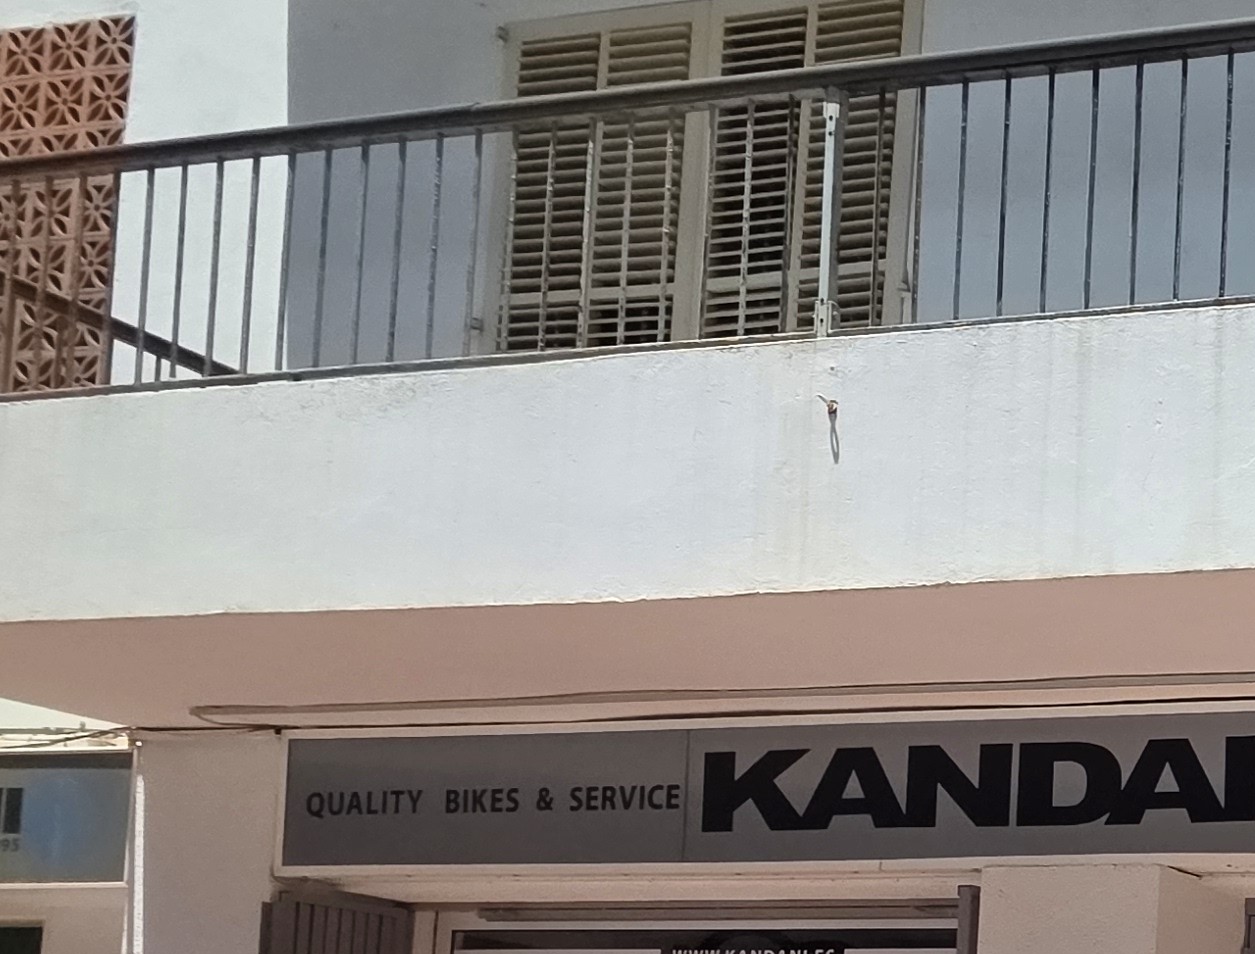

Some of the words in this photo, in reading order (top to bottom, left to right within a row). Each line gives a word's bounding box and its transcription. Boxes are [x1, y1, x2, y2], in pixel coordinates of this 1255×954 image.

[305, 789, 423, 819] QUALITY
[445, 788, 520, 814] BIKES
[536, 787, 554, 812] &
[569, 784, 681, 812] SERVICE
